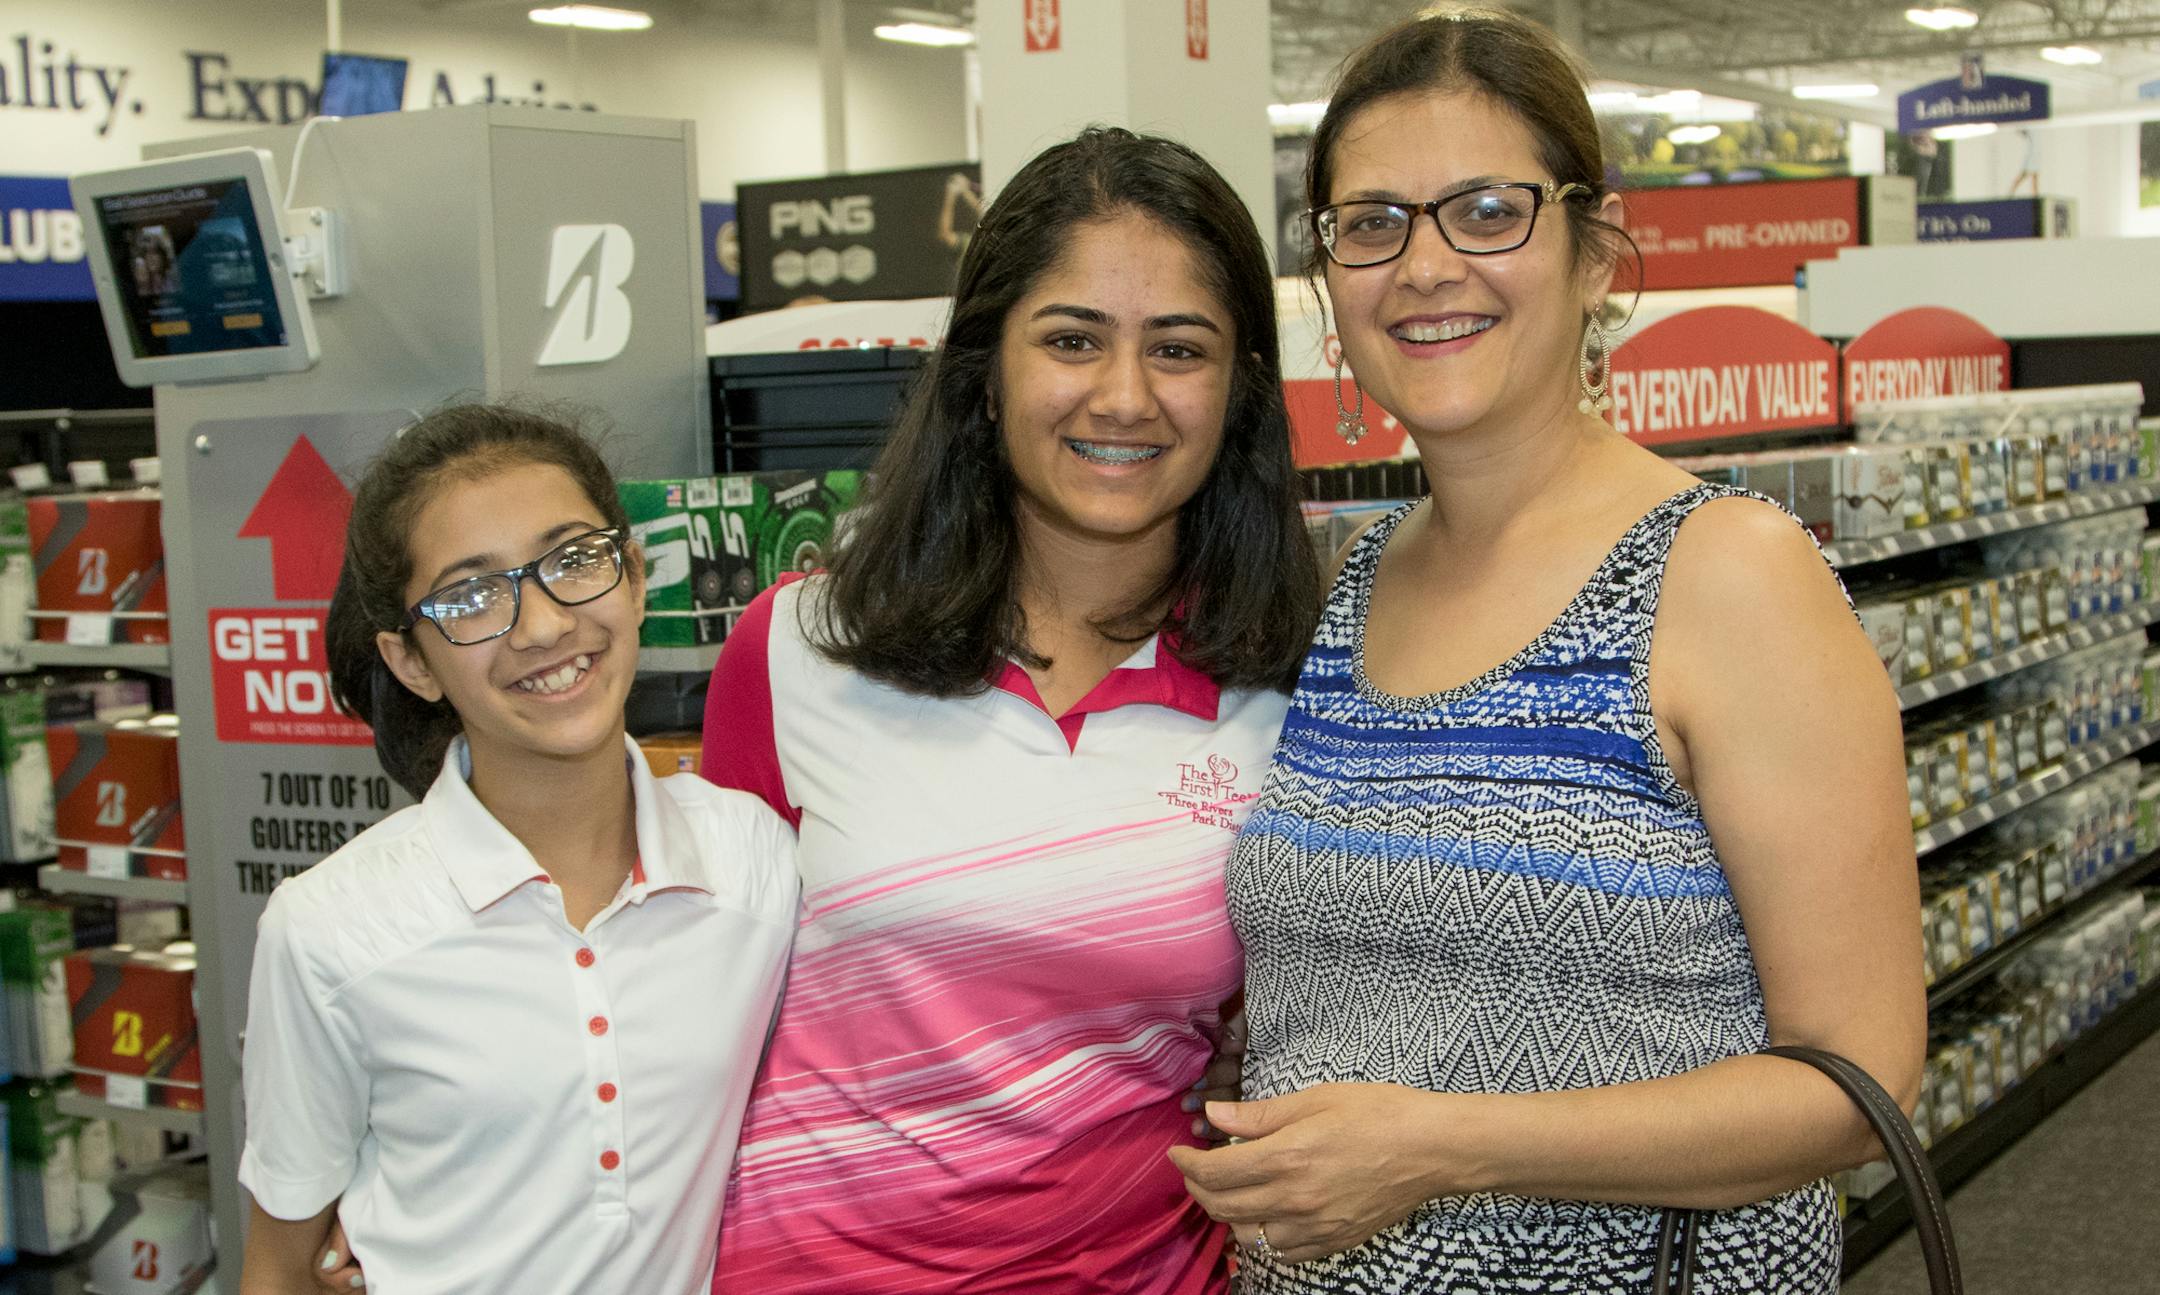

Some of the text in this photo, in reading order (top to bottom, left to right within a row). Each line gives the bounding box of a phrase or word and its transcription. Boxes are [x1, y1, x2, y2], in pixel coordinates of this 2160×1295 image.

[1915, 91, 2032, 121] Left-handed
[769, 195, 875, 239] PING
[1704, 218, 1850, 249] PRE-OWNED
[1849, 354, 2004, 402] EVERYDAY VALUE
[1613, 361, 1829, 434] EVERYDAY VALUE
[215, 617, 319, 662] GET
[1176, 763, 1208, 781] The
[261, 773, 390, 810] 7 OUT OF 10
[1167, 794, 1233, 817] Three Rivers
[1179, 780, 1212, 798] First
[252, 817, 347, 853] GOLFERS
[1192, 811, 1216, 826] Park
[235, 861, 276, 894] THE
